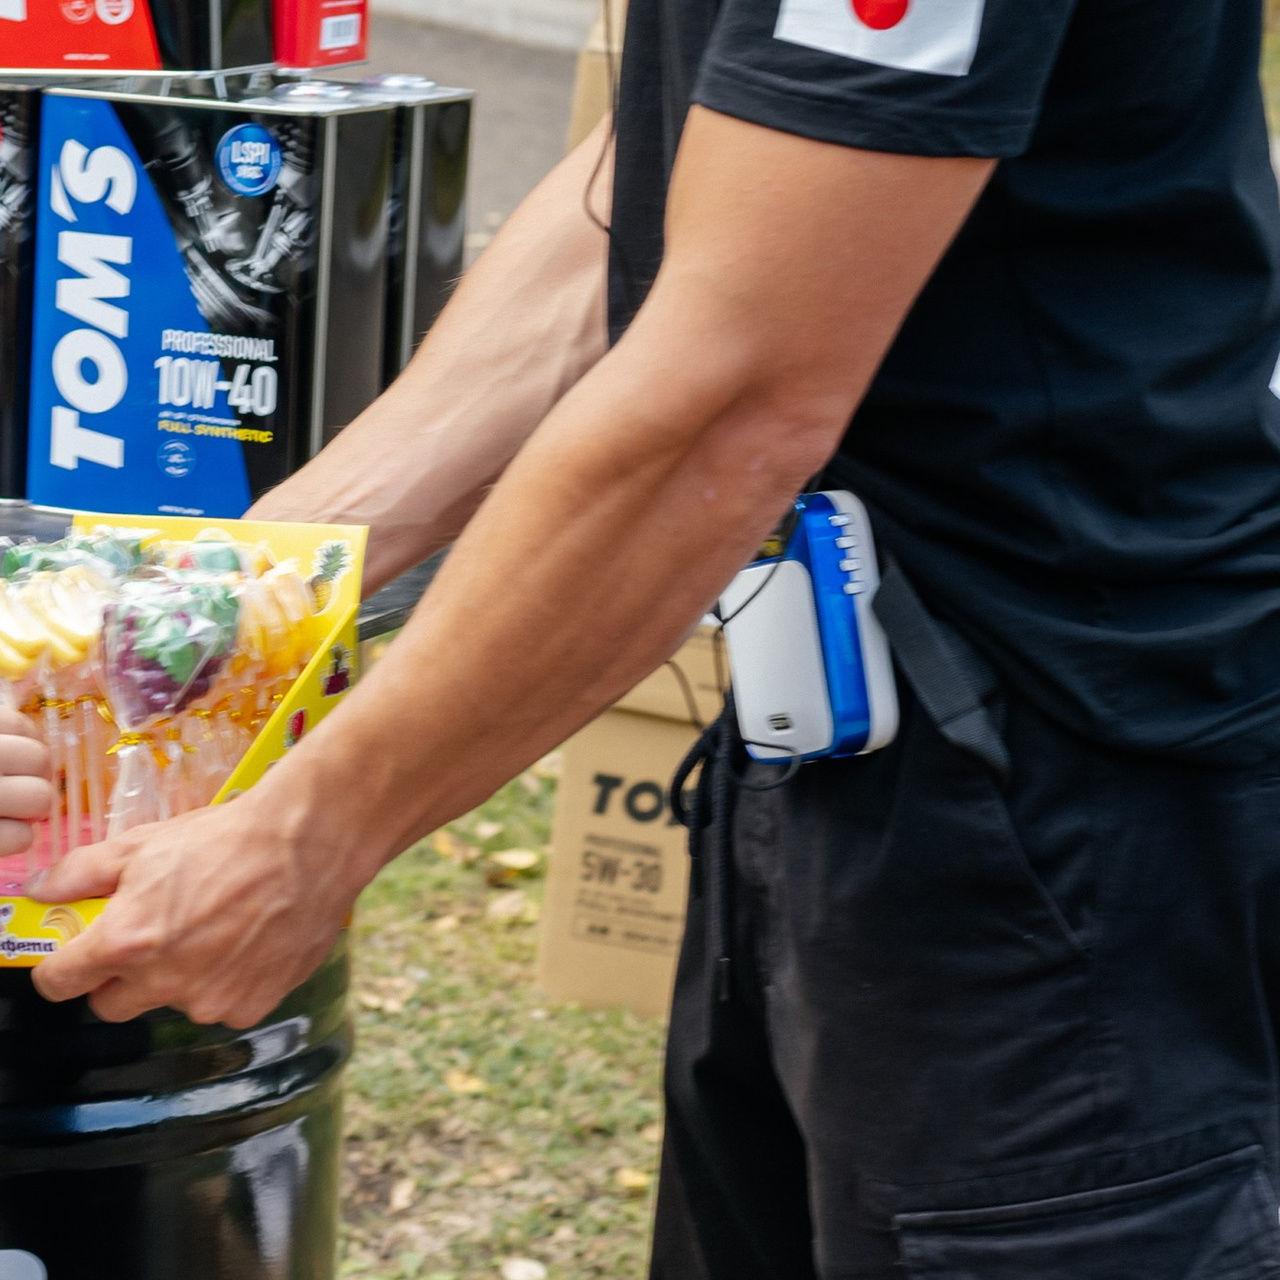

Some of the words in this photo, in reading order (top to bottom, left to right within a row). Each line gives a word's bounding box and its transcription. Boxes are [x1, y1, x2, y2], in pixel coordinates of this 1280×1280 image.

[50, 139, 138, 470] TOM'S
[161, 329, 279, 361] PROFESSIONAL
[154, 356, 278, 418] 10W-40
[592, 773, 683, 828] TO
